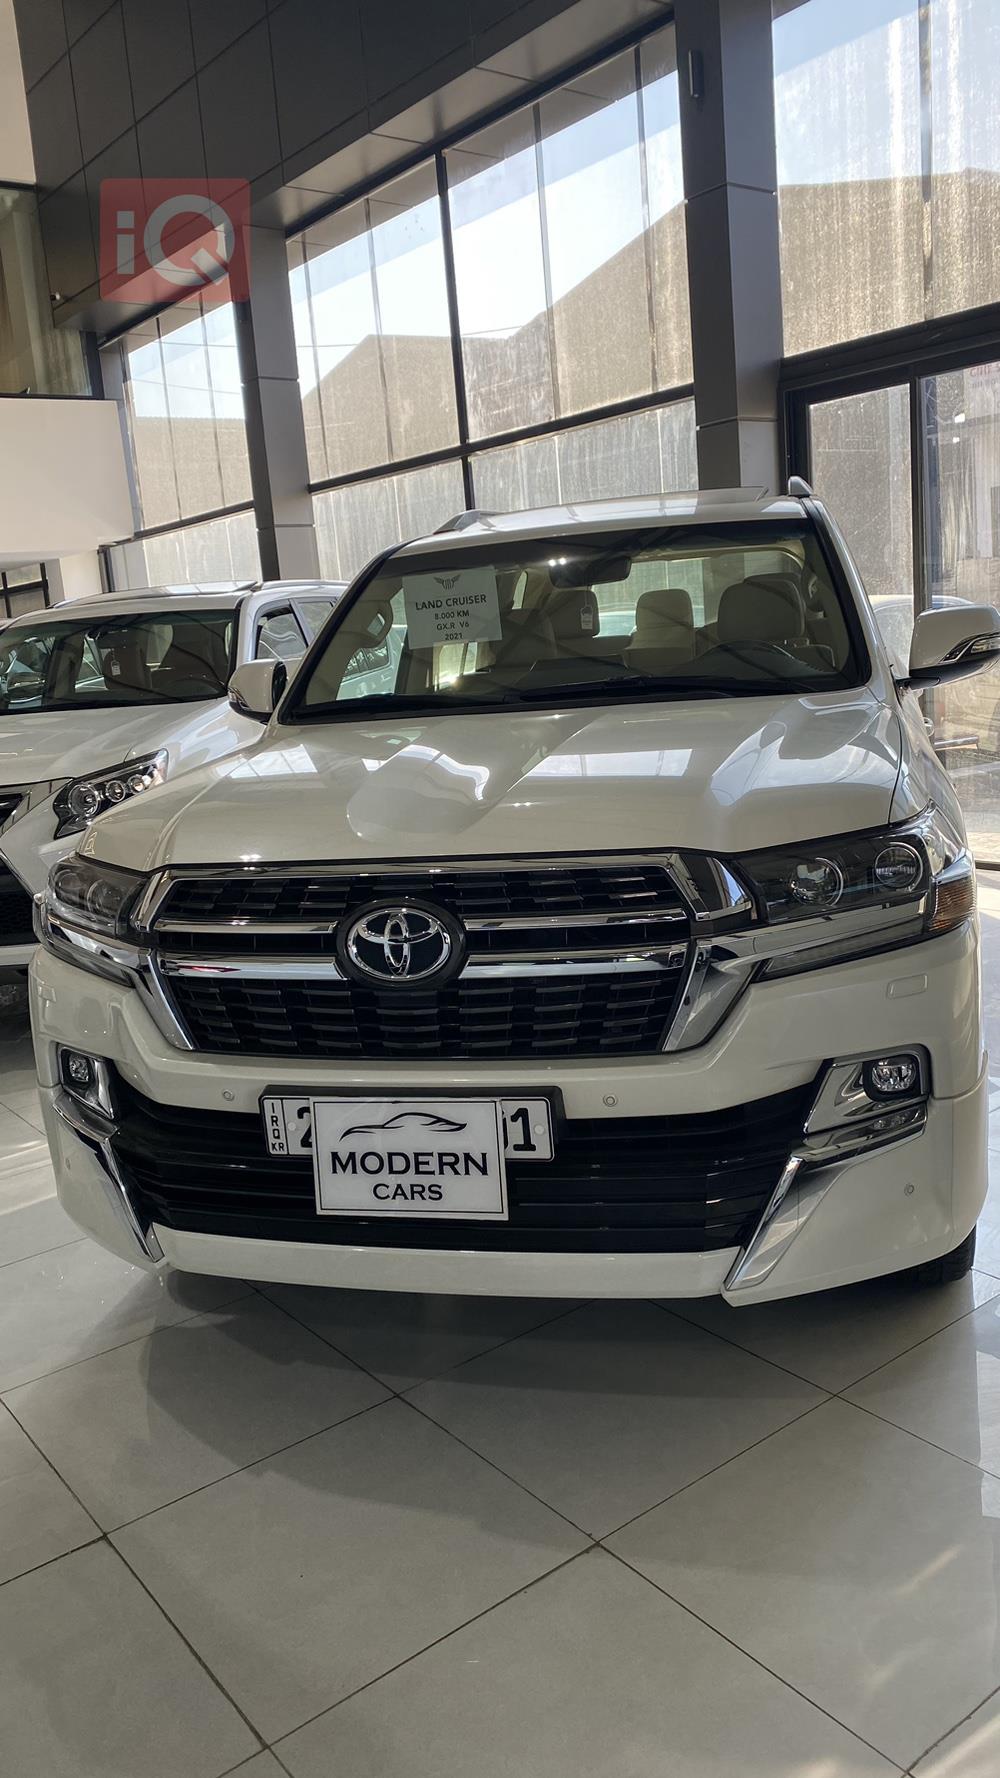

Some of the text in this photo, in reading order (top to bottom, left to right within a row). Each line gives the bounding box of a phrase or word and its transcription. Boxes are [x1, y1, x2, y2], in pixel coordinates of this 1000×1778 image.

[416, 594, 487, 610] LAND CRUISER
[457, 609, 470, 617] KM
[445, 632, 463, 640] 2021
[330, 1150, 489, 1177] MODERN
[372, 1182, 443, 1201] CARS
